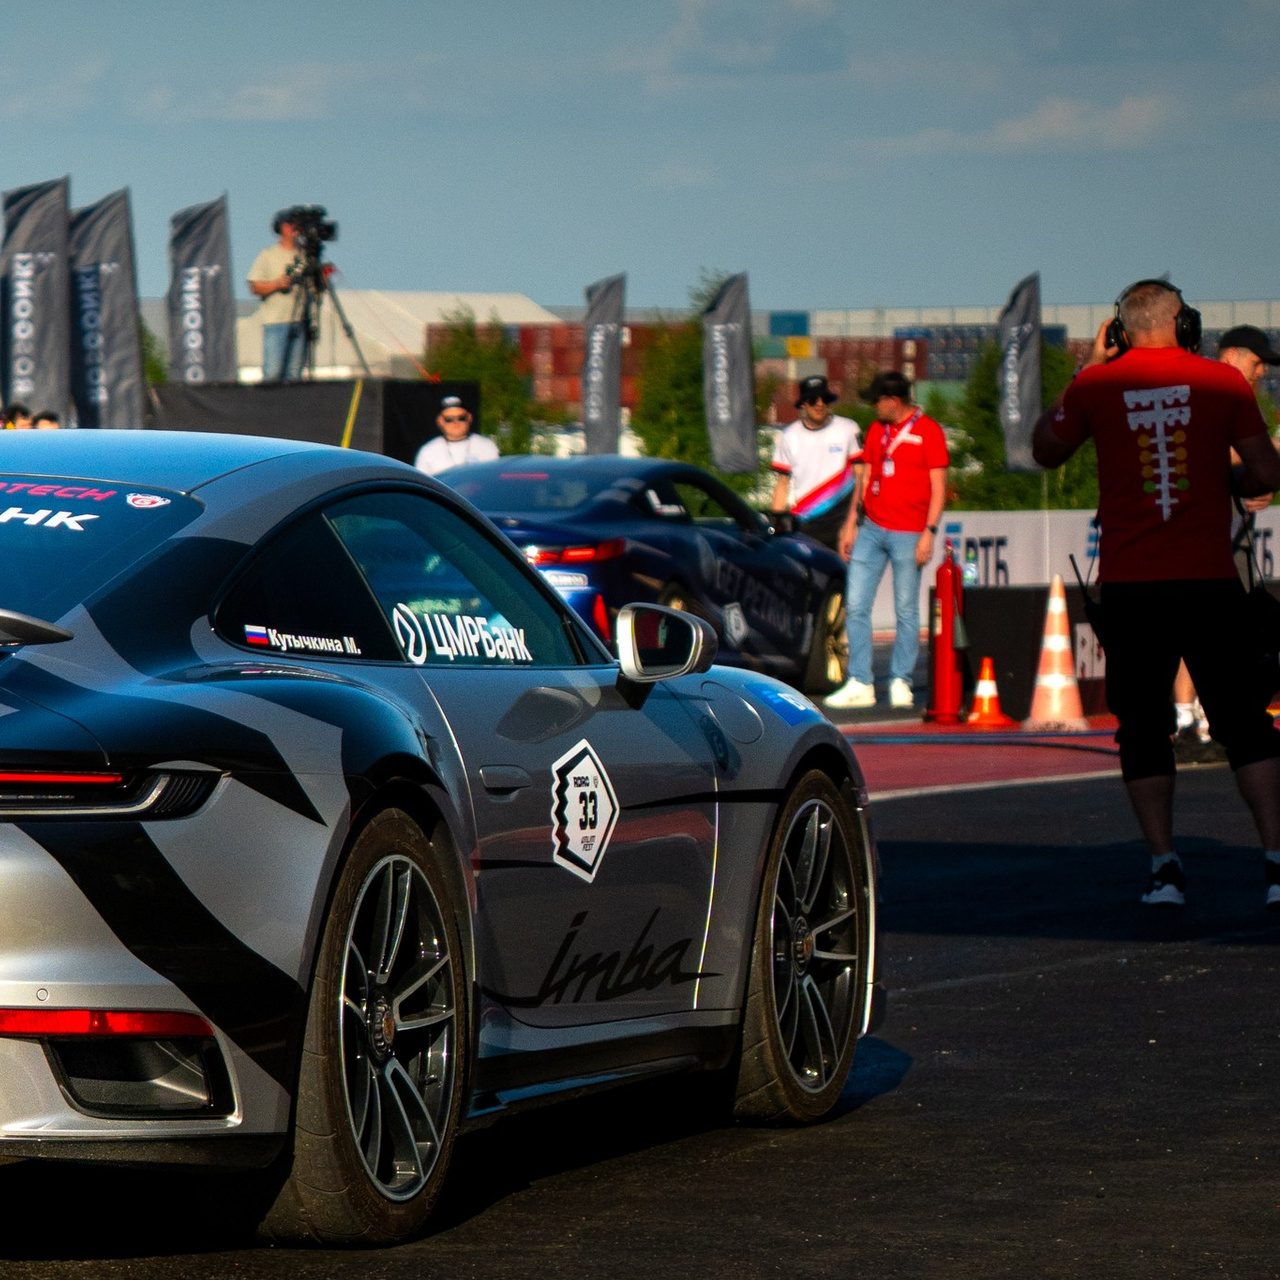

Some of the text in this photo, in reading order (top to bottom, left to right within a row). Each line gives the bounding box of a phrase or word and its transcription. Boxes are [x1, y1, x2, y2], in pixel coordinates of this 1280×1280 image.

[267, 628, 361, 655] Кутычкина М.
[424, 613, 532, 661] ЦМРБанк
[579, 791, 598, 830] 33
